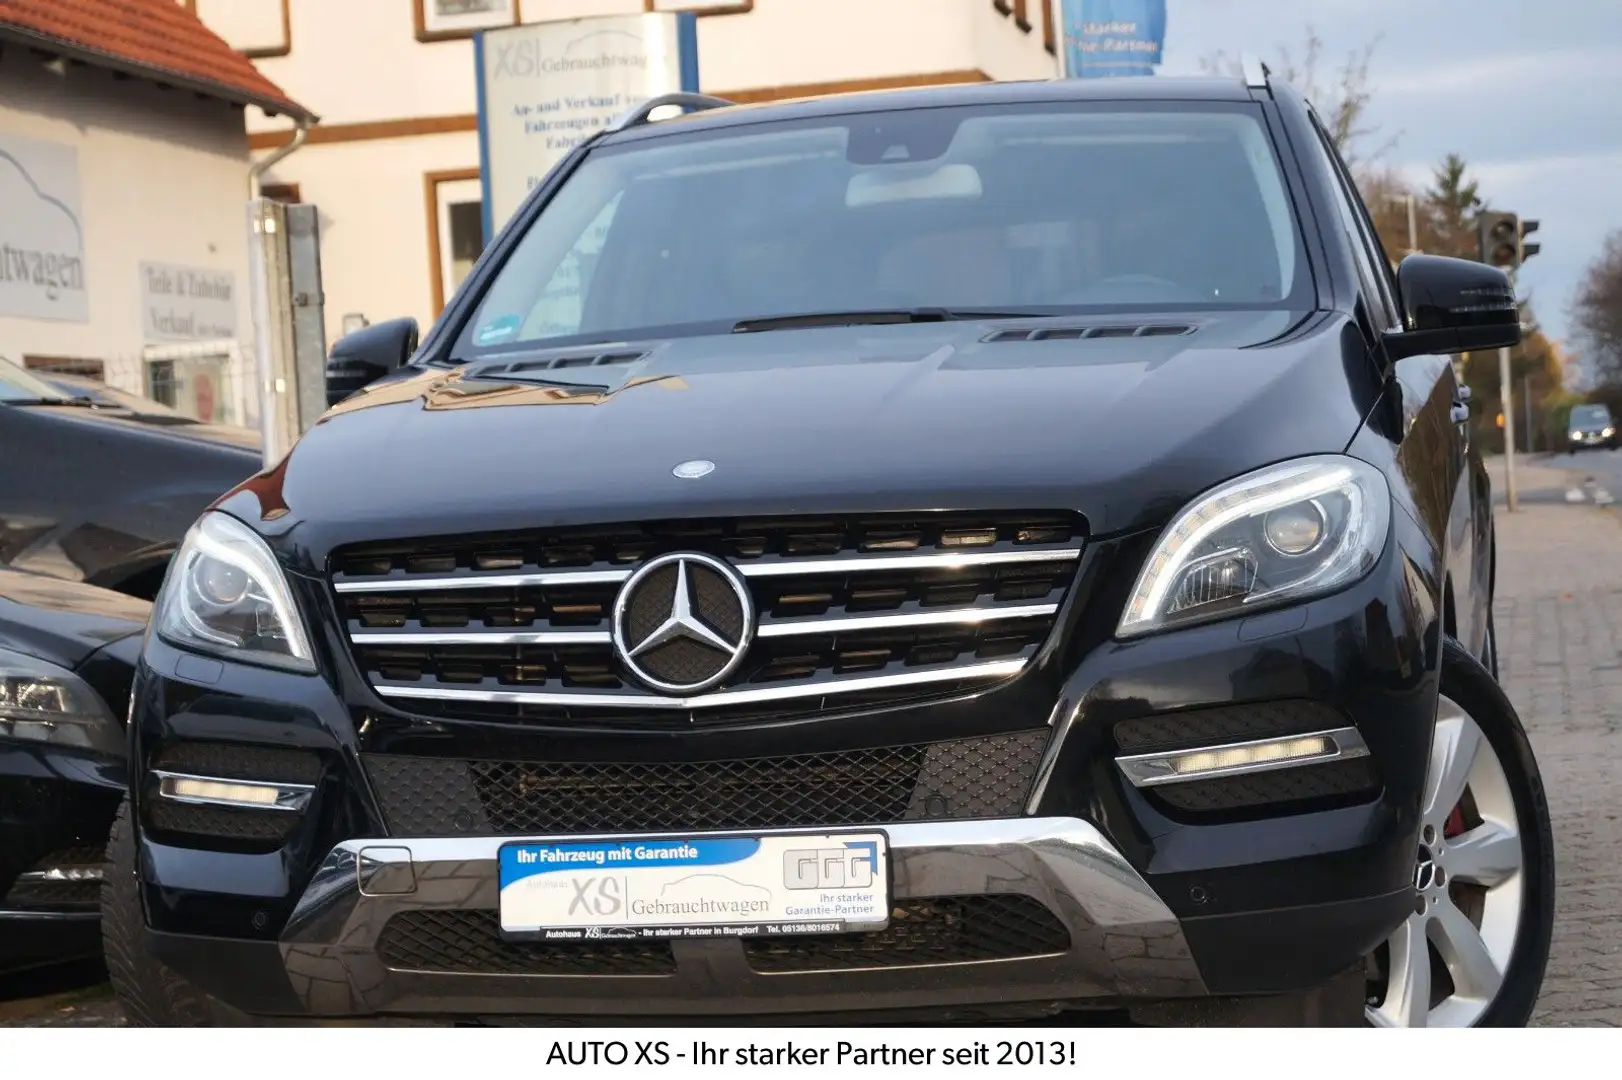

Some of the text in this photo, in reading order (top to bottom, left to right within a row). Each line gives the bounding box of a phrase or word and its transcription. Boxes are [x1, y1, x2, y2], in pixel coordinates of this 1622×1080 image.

[537, 99, 559, 113] und
[569, 94, 620, 108] Verkauf
[525, 116, 598, 133] Fahrzeugen
[517, 845, 698, 864] Ihr Fahrzeug mit Garantie
[569, 877, 621, 916] XS
[632, 897, 769, 916] Gebrauchtwagen
[820, 893, 873, 903] Ihr starker
[785, 904, 875, 916] Garantie-Partner
[546, 930, 582, 938] Autohaus
[585, 926, 601, 939] XS
[643, 928, 654, 936] Ihr
[655, 928, 682, 936] starker
[684, 925, 712, 935] Partner
[714, 926, 721, 935] in
[723, 925, 759, 936] Burgdorf
